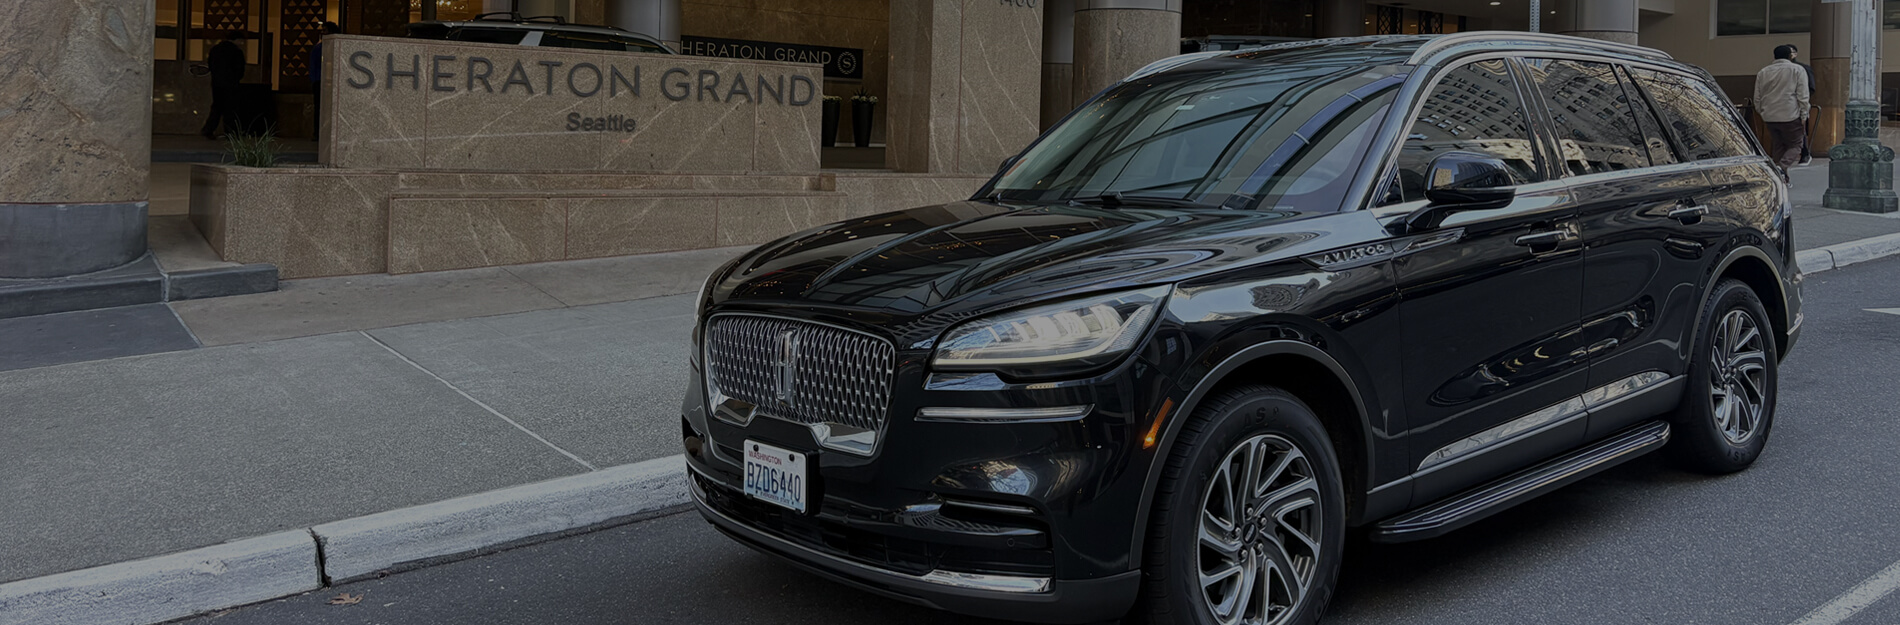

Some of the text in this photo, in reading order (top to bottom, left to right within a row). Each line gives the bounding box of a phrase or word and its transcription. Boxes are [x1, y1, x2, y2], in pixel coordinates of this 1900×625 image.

[681, 40, 832, 65] HERATON GRAND
[348, 51, 815, 106] SHERATON GRAND
[566, 112, 636, 132] Seattle
[1324, 244, 1385, 264] AVIATOR
[749, 450, 782, 465] WASHINGTON
[747, 461, 801, 502] BZD6440
